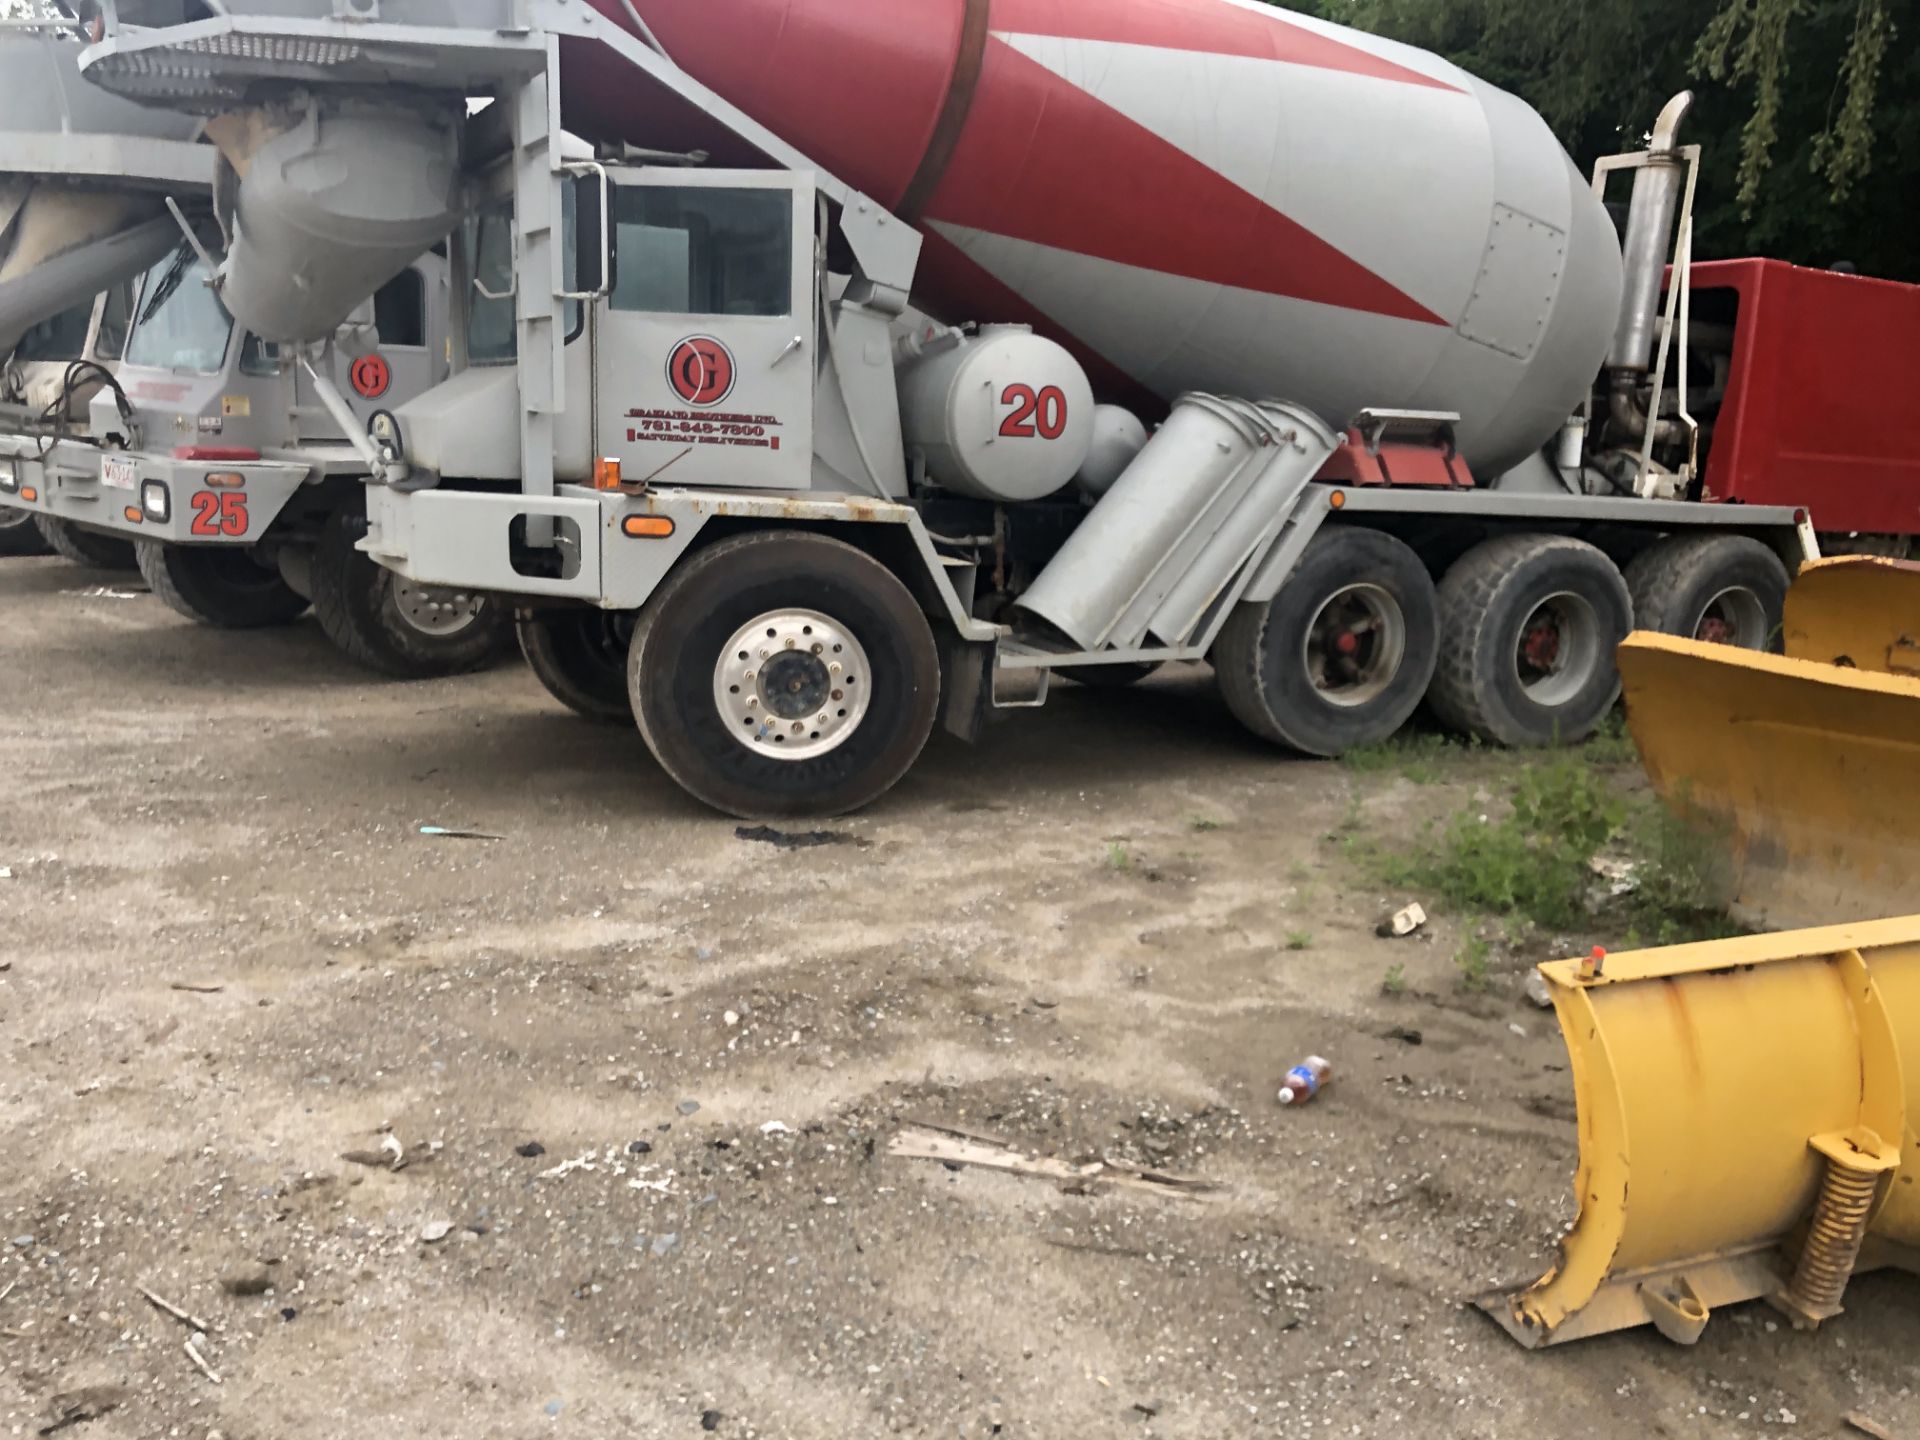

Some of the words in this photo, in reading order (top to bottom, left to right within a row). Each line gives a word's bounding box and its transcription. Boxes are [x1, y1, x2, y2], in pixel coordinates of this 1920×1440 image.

[998, 382, 1067, 440] 20
[637, 432, 696, 443] SATURDAY
[191, 490, 249, 537] 25
